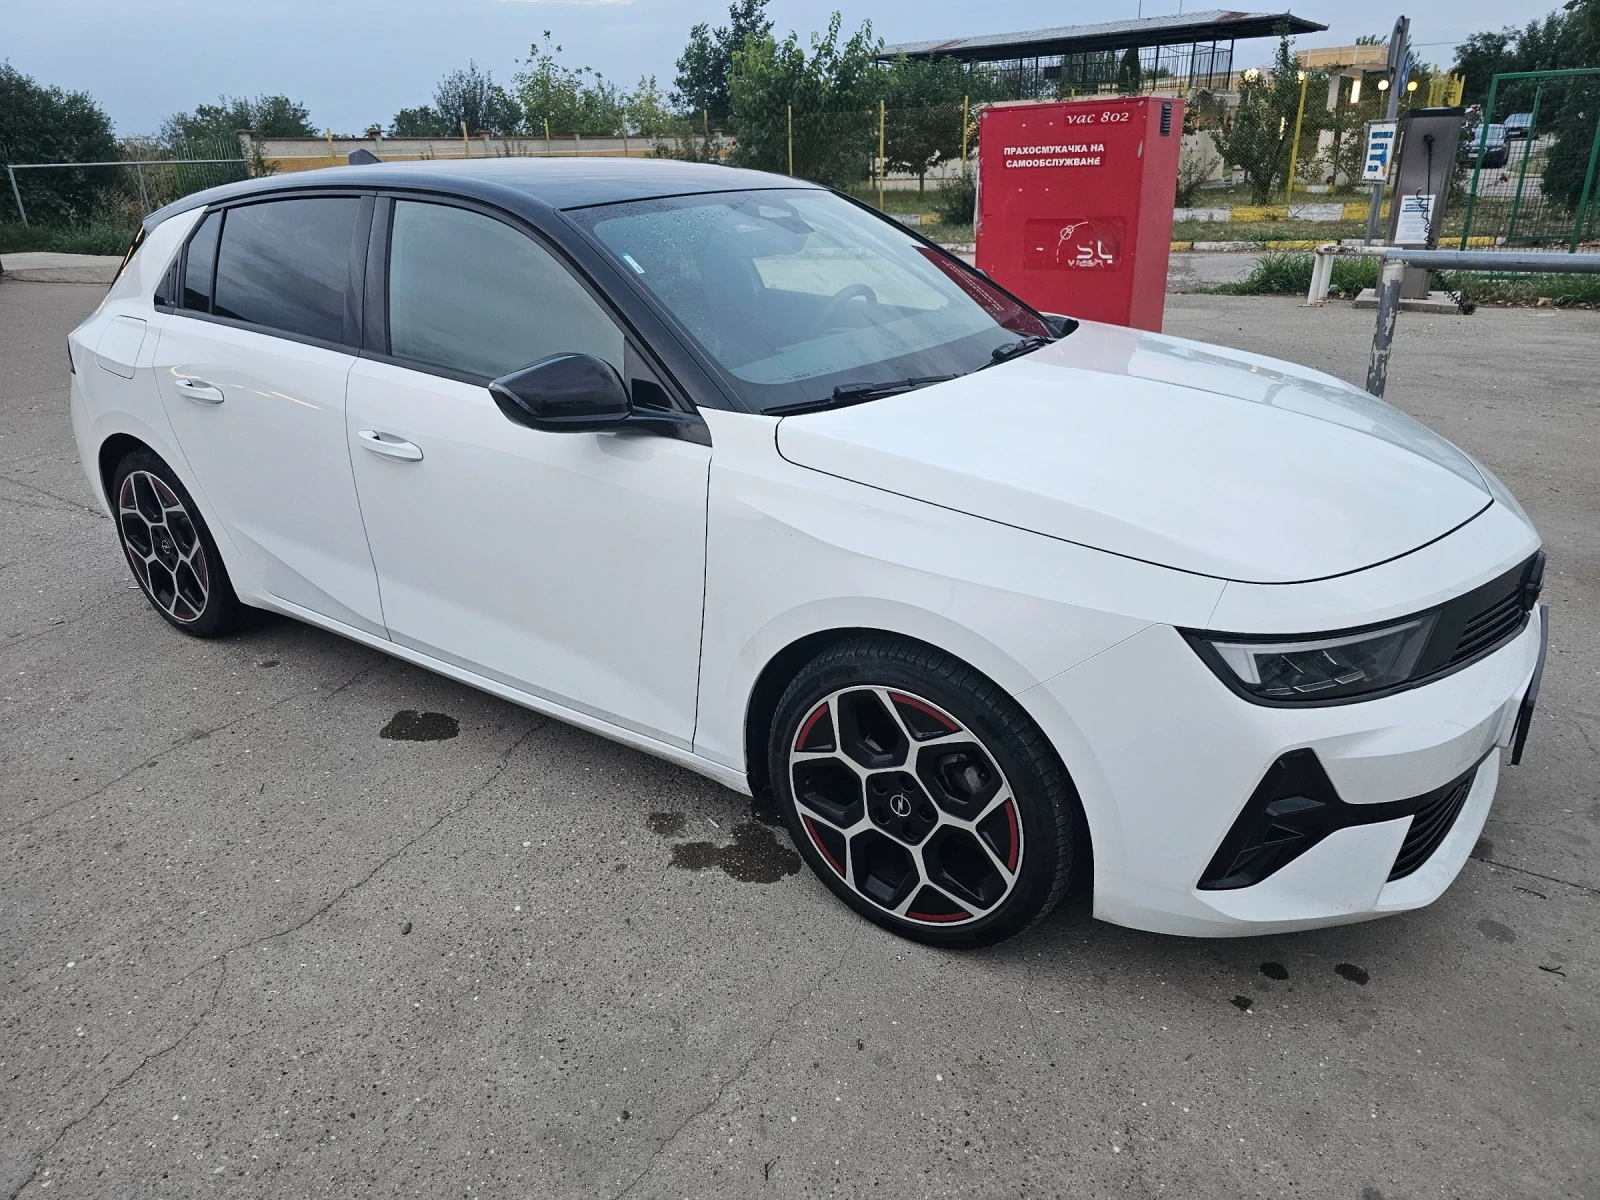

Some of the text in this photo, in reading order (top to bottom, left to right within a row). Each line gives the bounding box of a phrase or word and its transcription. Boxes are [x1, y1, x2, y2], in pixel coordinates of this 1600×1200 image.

[1066, 111, 1129, 124] vac 802
[1003, 143, 1105, 155] ПРАХОСМУКАЧКА НА
[1006, 157, 1101, 168] САМООБСЛУЖВАНЕ
